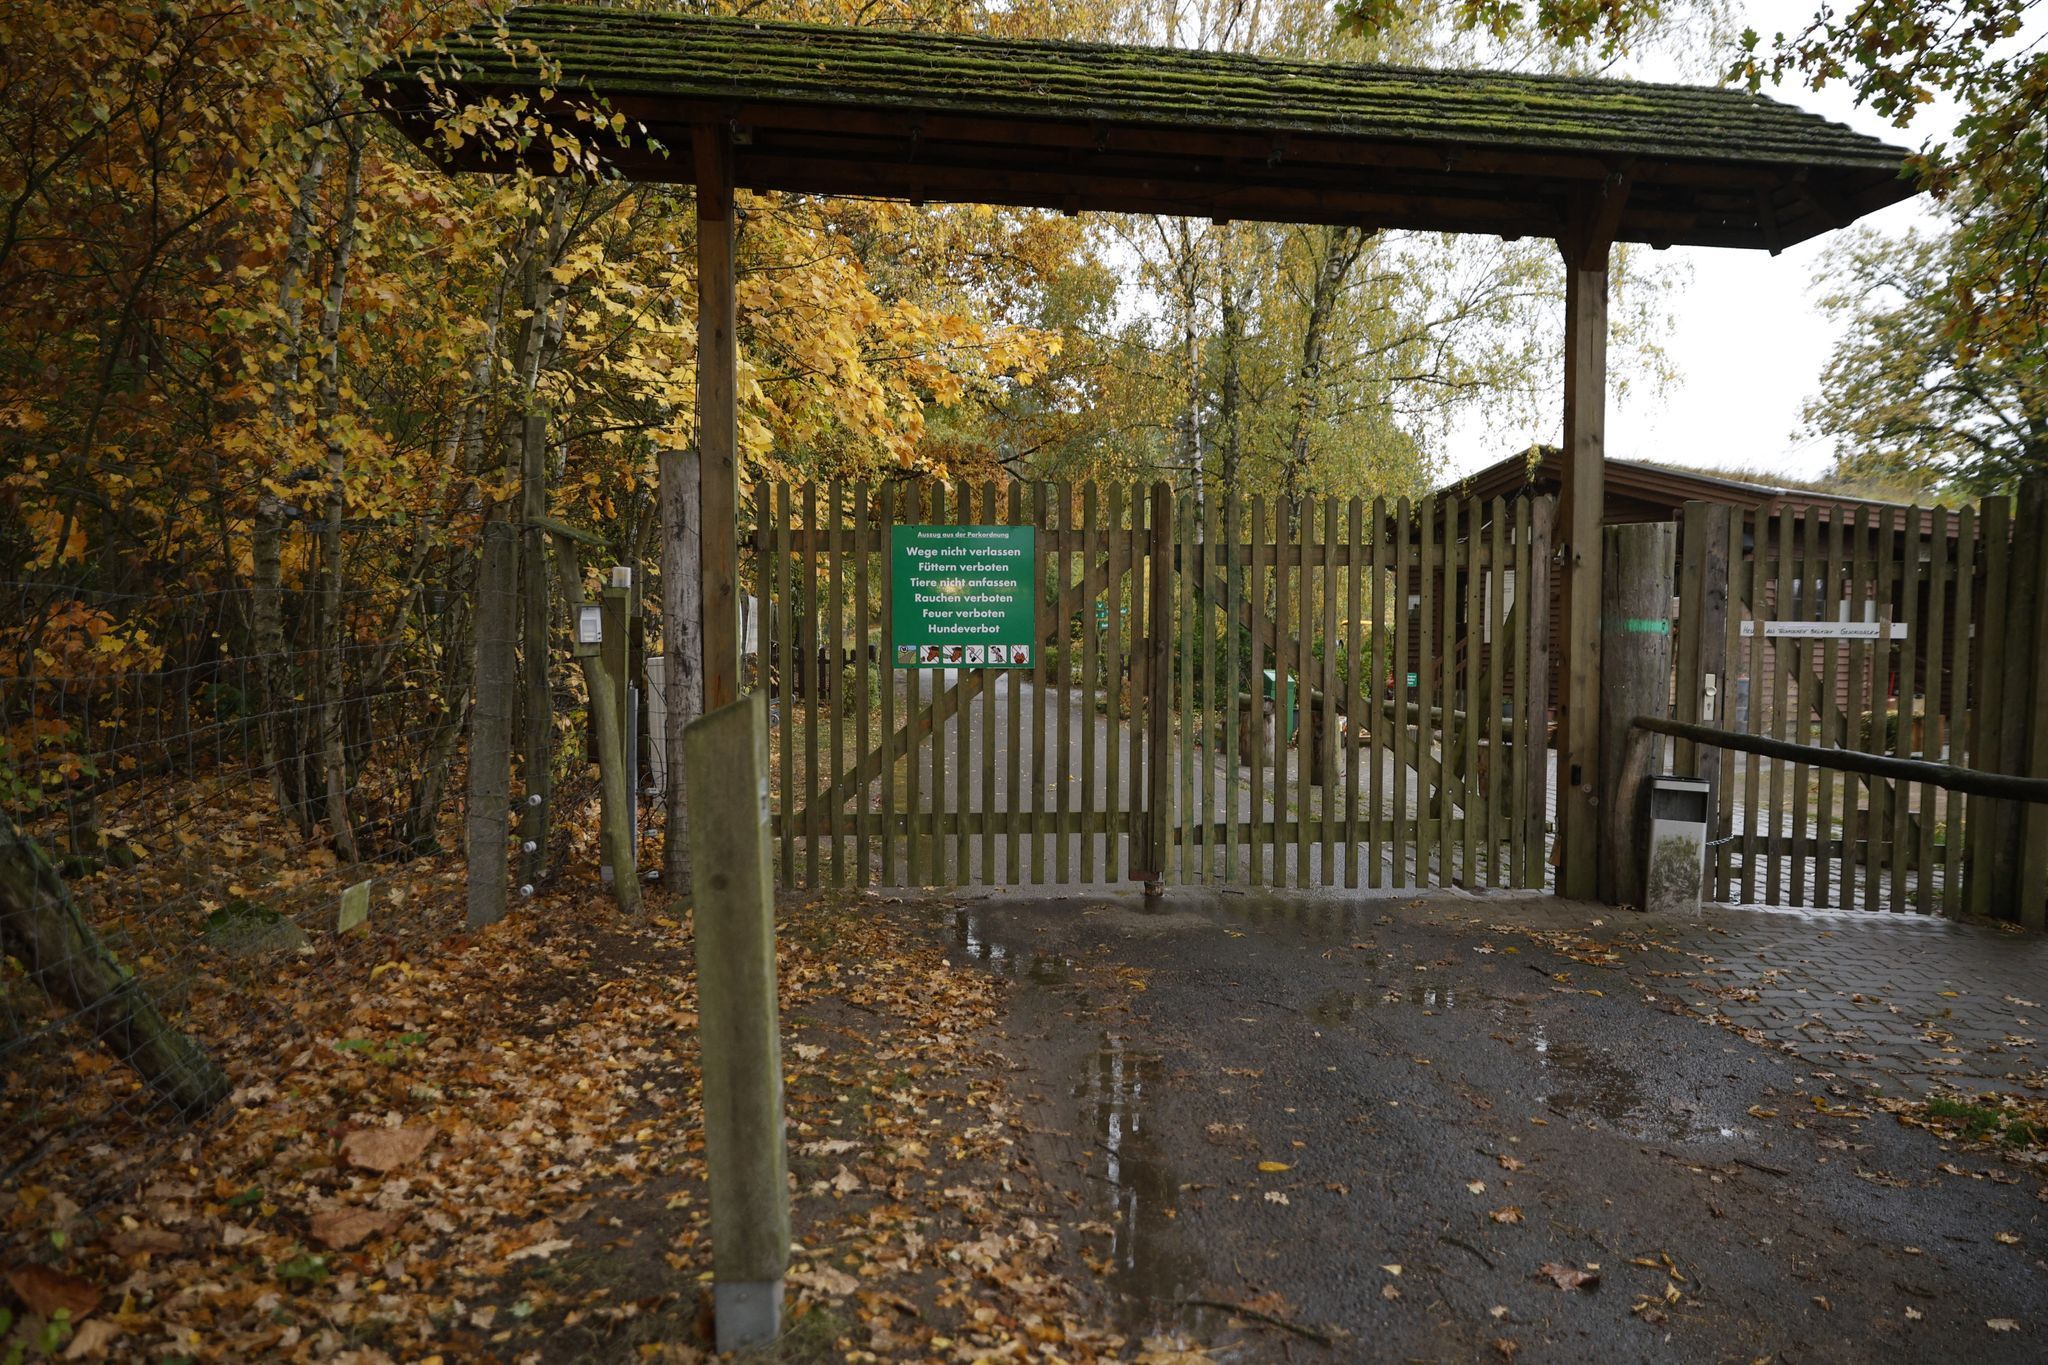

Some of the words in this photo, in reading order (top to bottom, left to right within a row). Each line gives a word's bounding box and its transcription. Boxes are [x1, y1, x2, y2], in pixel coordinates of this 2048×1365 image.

[906, 547, 938, 558] Wege
[941, 547, 967, 556] nicht
[969, 547, 1021, 556] verlassen
[919, 562, 956, 571] Füttern
[960, 562, 1009, 571] verboten
[910, 578, 937, 587] Tiere
[940, 578, 965, 587] nicht
[968, 577, 1017, 587] anfassen
[915, 593, 960, 602] Rauchen
[964, 593, 1013, 602] verboten
[923, 609, 953, 618] Feuer
[956, 609, 1005, 618] verboten
[928, 624, 1000, 633] Hundeverbot
